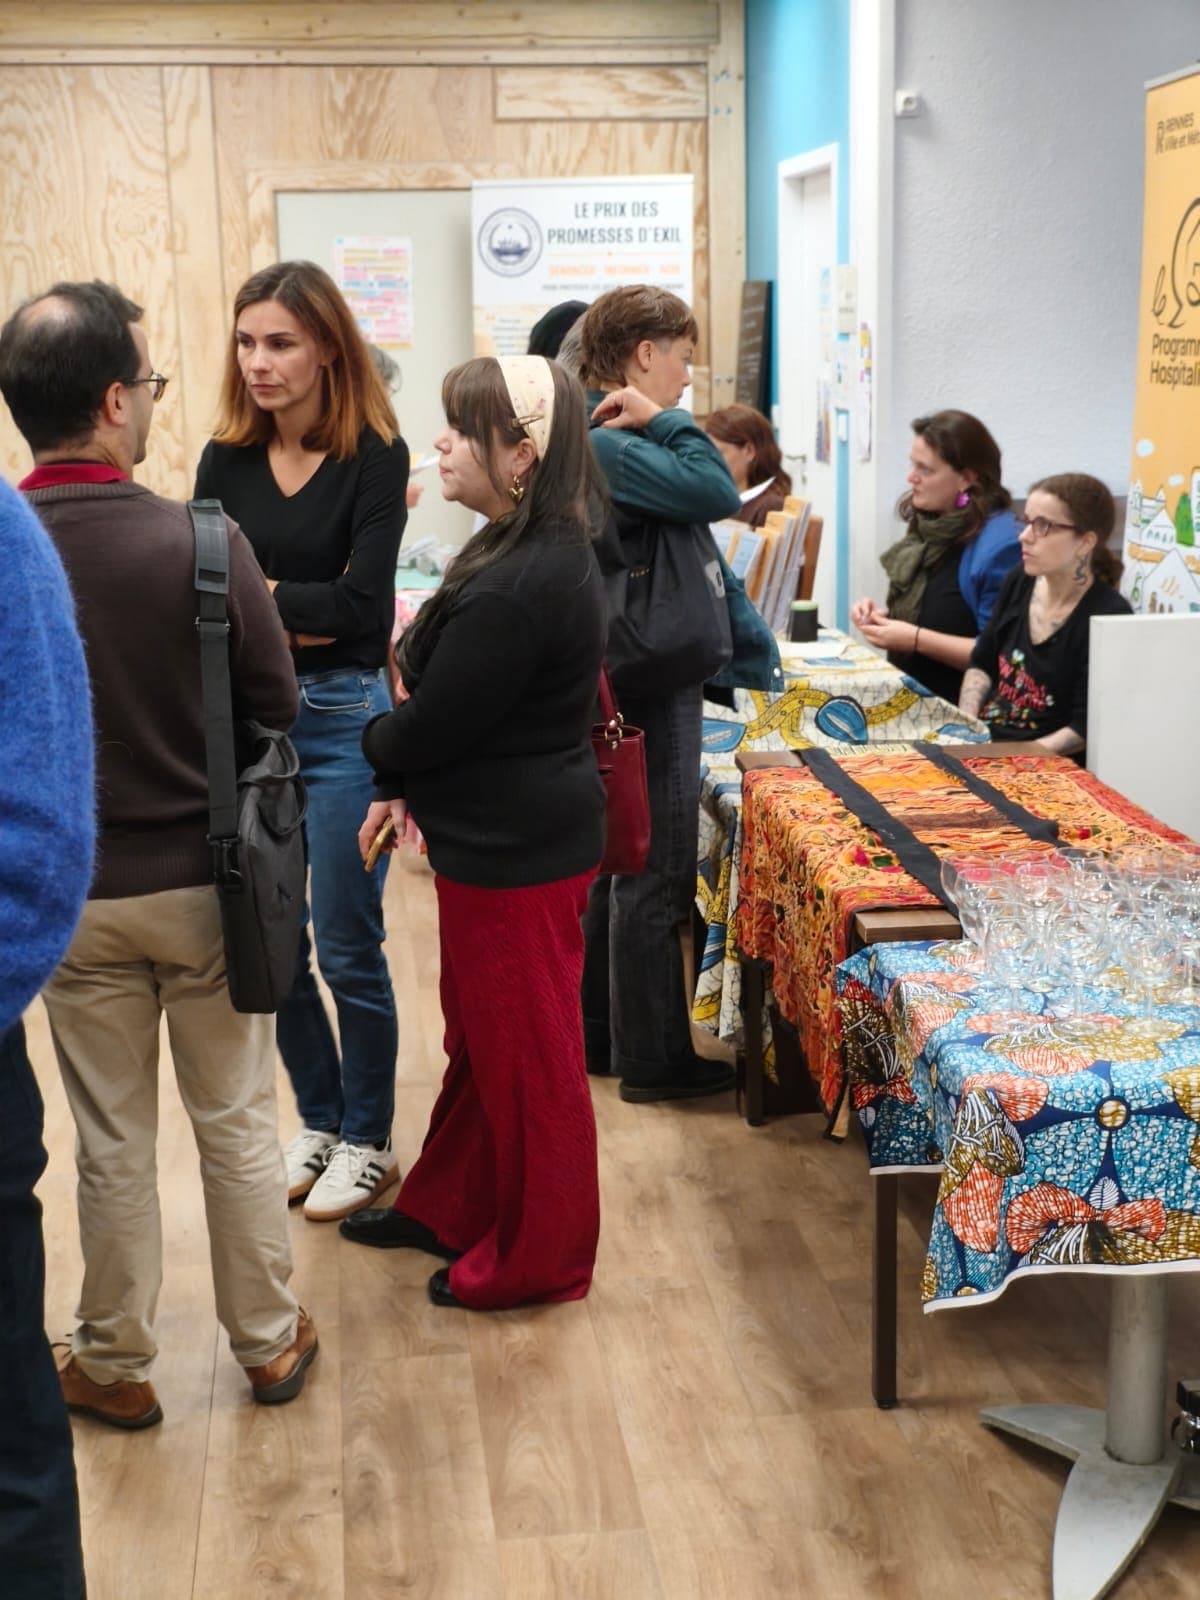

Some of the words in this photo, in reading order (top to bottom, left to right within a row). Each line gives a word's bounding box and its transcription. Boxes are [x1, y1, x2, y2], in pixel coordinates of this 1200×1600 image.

[574, 202, 589, 219] LE
[593, 201, 626, 218] PRIX
[632, 201, 658, 218] DES
[547, 227, 633, 244] PROMESSES
[639, 226, 681, 243] D'EXIL
